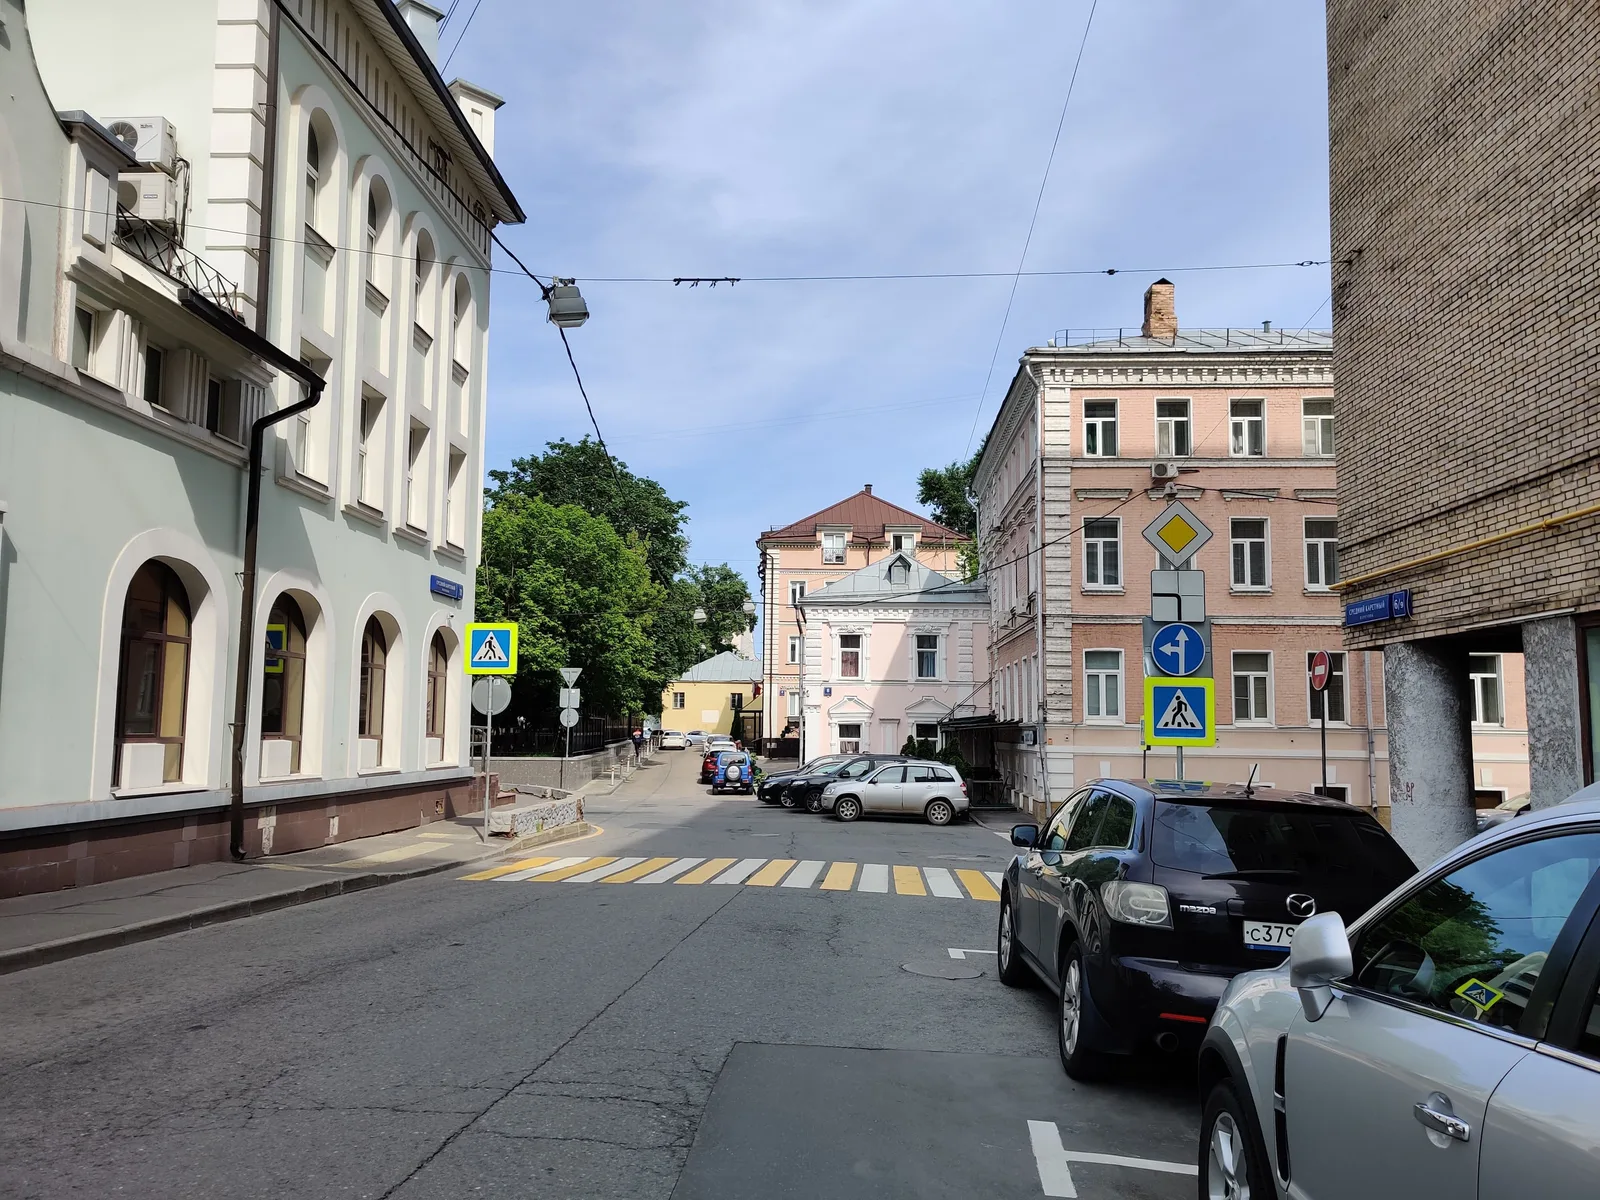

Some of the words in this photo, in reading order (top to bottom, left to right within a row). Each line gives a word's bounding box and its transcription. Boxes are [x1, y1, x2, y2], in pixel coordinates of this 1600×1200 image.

[1349, 605, 1365, 616] СРЕДНИЙ
[1365, 600, 1385, 612] КАРЕТНЫЙ
[1394, 599, 1404, 610] 6/9
[1179, 904, 1217, 915] mazda
